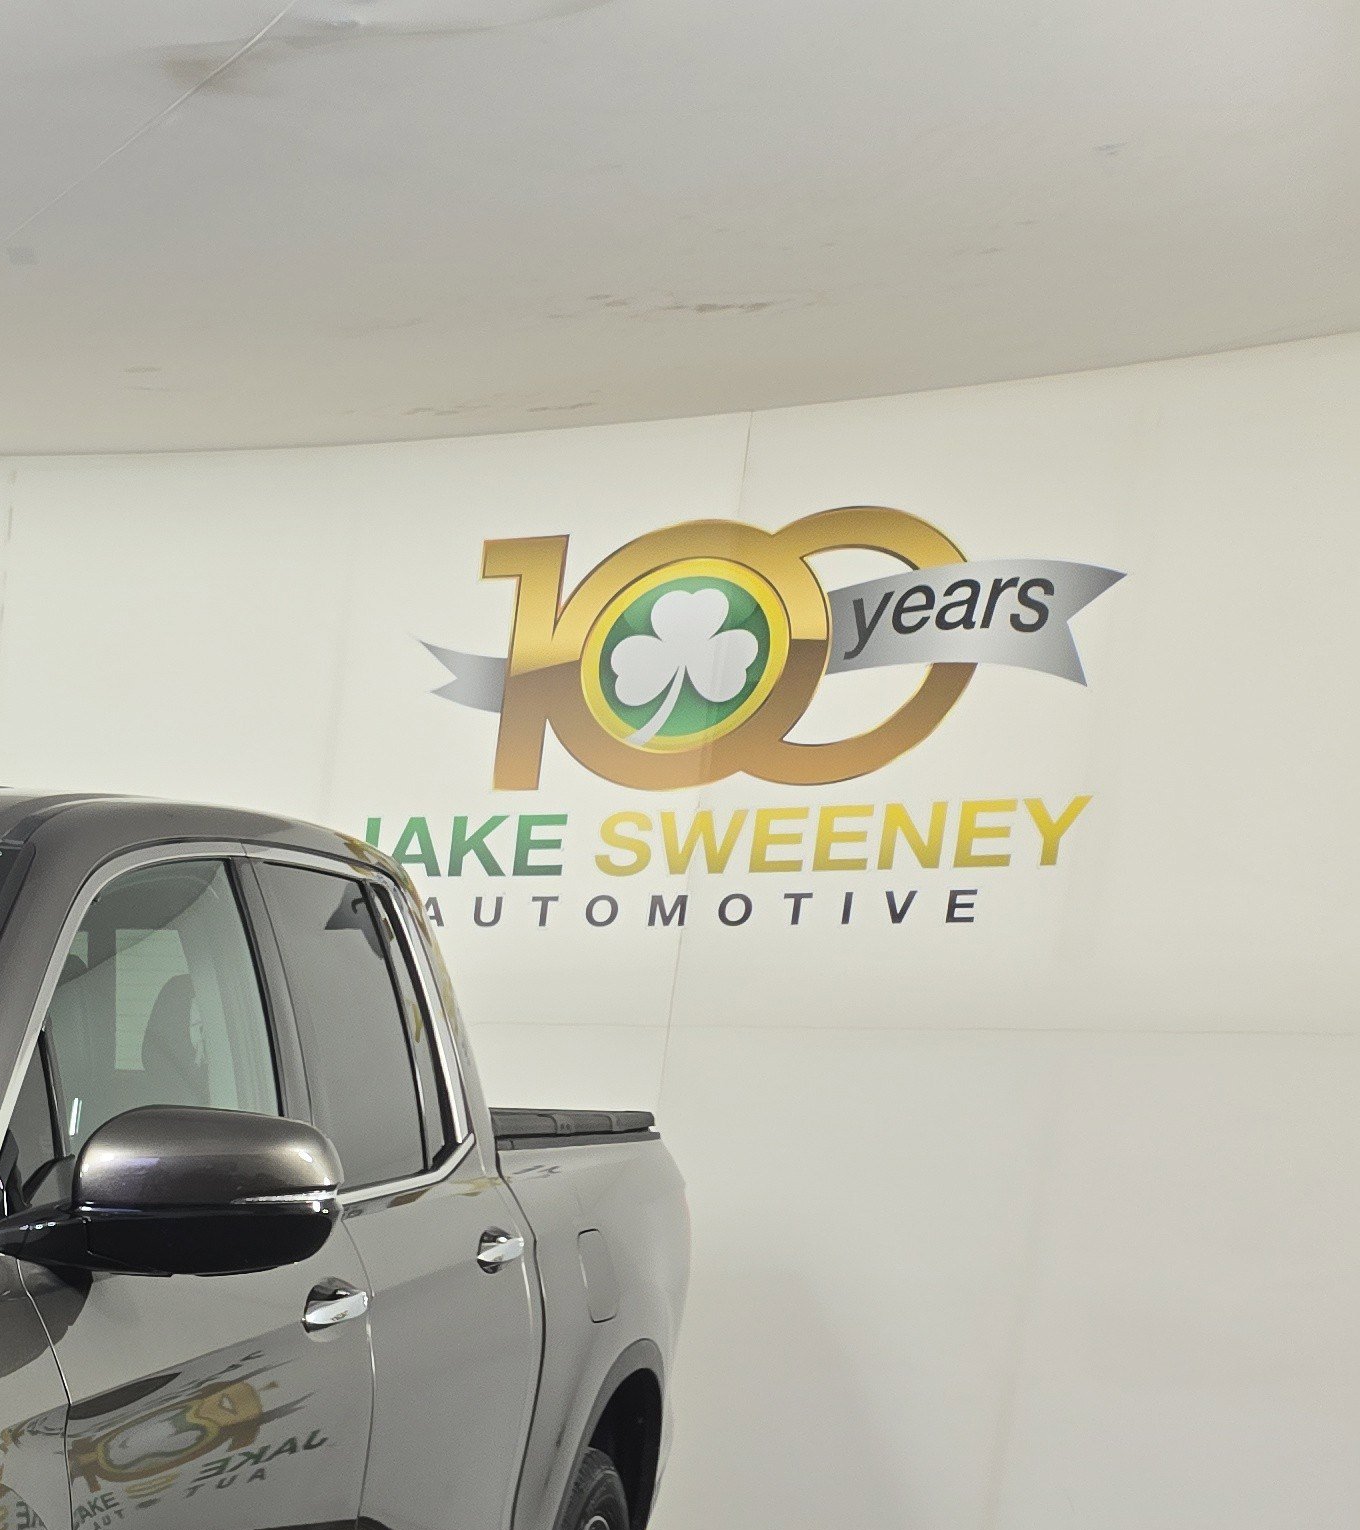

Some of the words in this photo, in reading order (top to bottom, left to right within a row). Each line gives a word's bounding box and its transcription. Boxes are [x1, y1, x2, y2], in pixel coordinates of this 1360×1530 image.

[479, 505, 978, 791] 100
[843, 575, 1055, 660] years
[594, 795, 1093, 877] SWEENEY
[424, 888, 979, 928] AUTOMOTIVE
